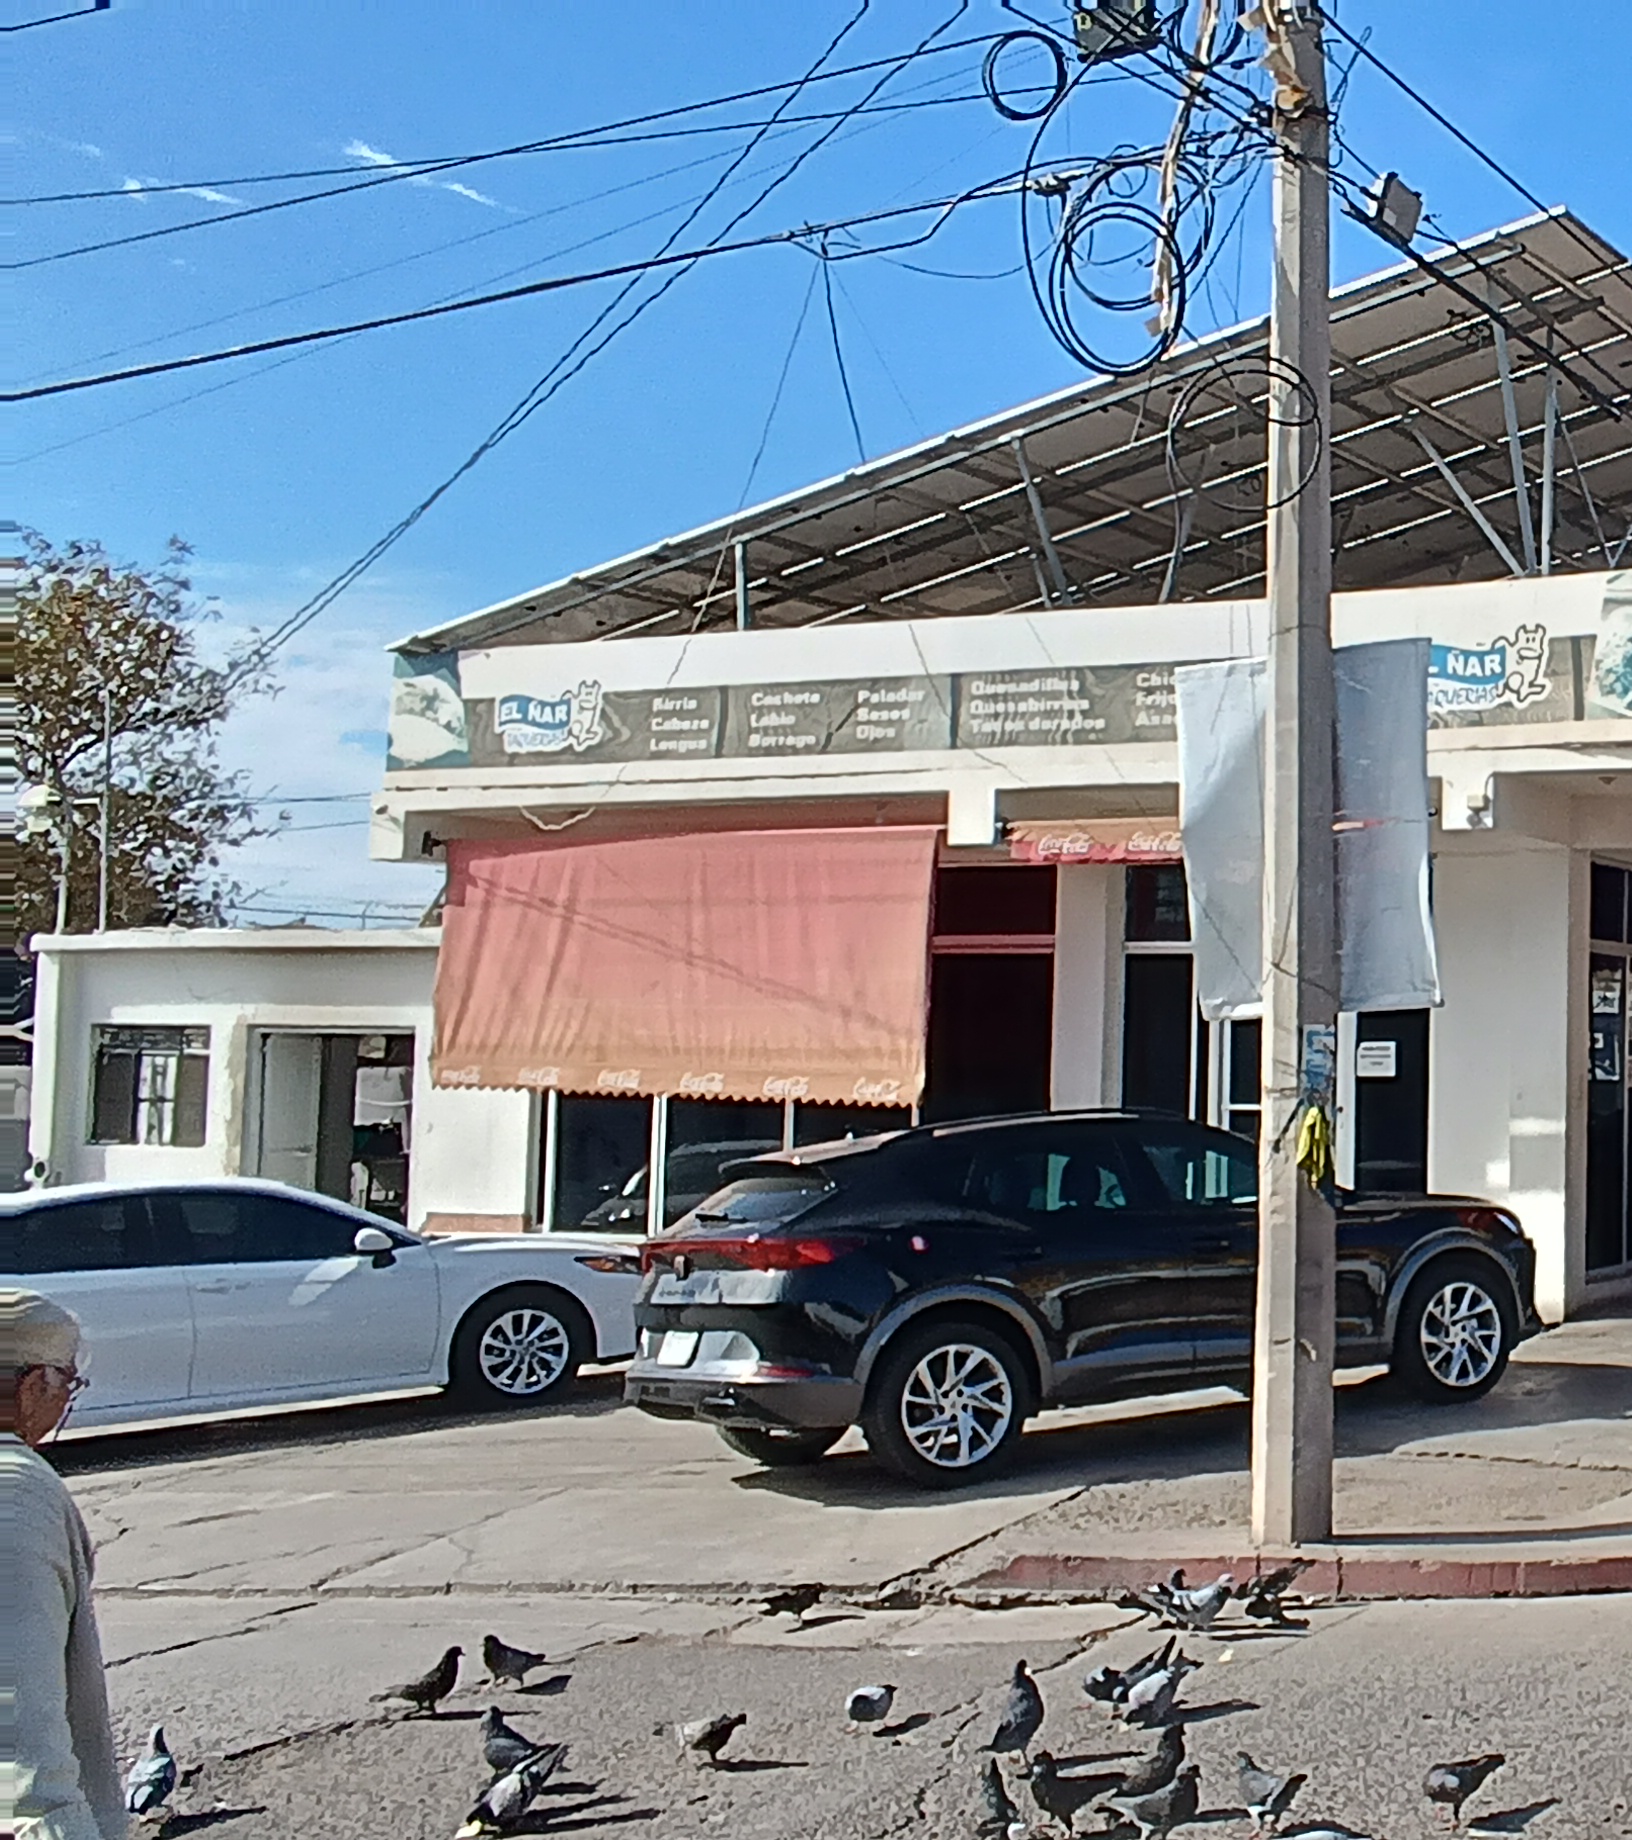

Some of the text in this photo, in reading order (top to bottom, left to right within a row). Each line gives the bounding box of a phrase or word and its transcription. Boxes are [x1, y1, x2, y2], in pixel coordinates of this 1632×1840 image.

[1446, 649, 1502, 677] ÑAR
[500, 700, 568, 724] EL ÑAR
